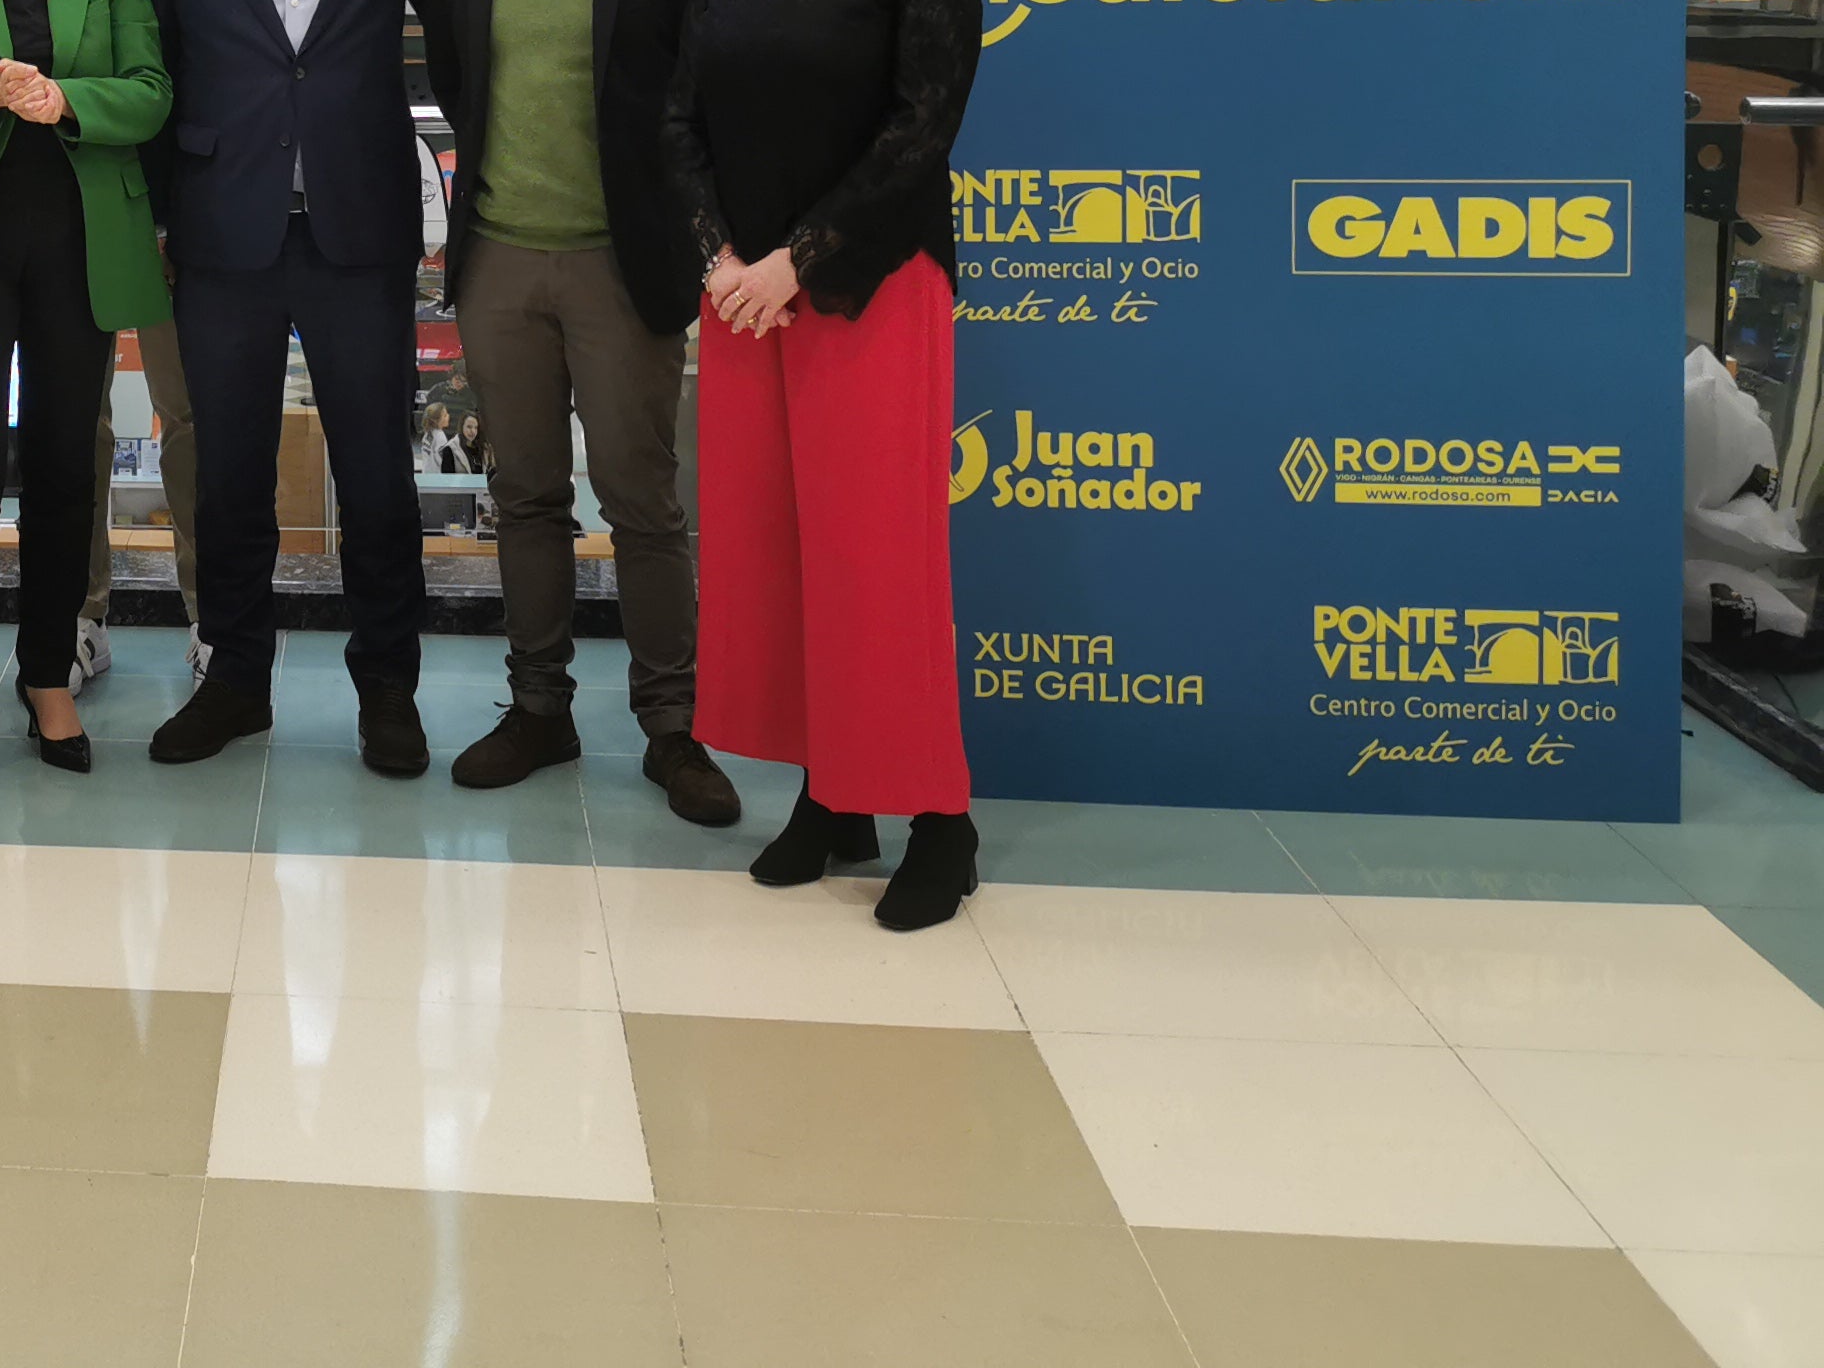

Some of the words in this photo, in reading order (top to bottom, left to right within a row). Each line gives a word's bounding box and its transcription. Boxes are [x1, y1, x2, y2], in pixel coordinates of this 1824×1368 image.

[1309, 197, 1613, 258] GADIS
[991, 258, 1112, 279] Comercial
[1120, 264, 1134, 284] y
[1142, 258, 1199, 279] Ocio
[1058, 296, 1095, 323] de
[1112, 293, 1157, 322] ti
[1012, 410, 1154, 472] Juan
[1334, 438, 1540, 474] RODOSA
[991, 467, 1202, 513] Soñador
[1365, 487, 1513, 504] www.rodosa.com
[1549, 491, 1618, 503] DACIA
[1313, 606, 1458, 646] PONTE
[976, 633, 1113, 665] XUNTA
[1313, 643, 1456, 683] VELLA
[975, 670, 1023, 699] DE
[1035, 672, 1203, 705] GALICIA
[1311, 694, 1395, 718] Centro
[1404, 697, 1528, 721] Comercial
[1537, 705, 1550, 725] y
[1558, 700, 1617, 721] Ocio
[1349, 732, 1461, 776] parte
[1473, 737, 1512, 764] de
[1527, 735, 1575, 765] ti
